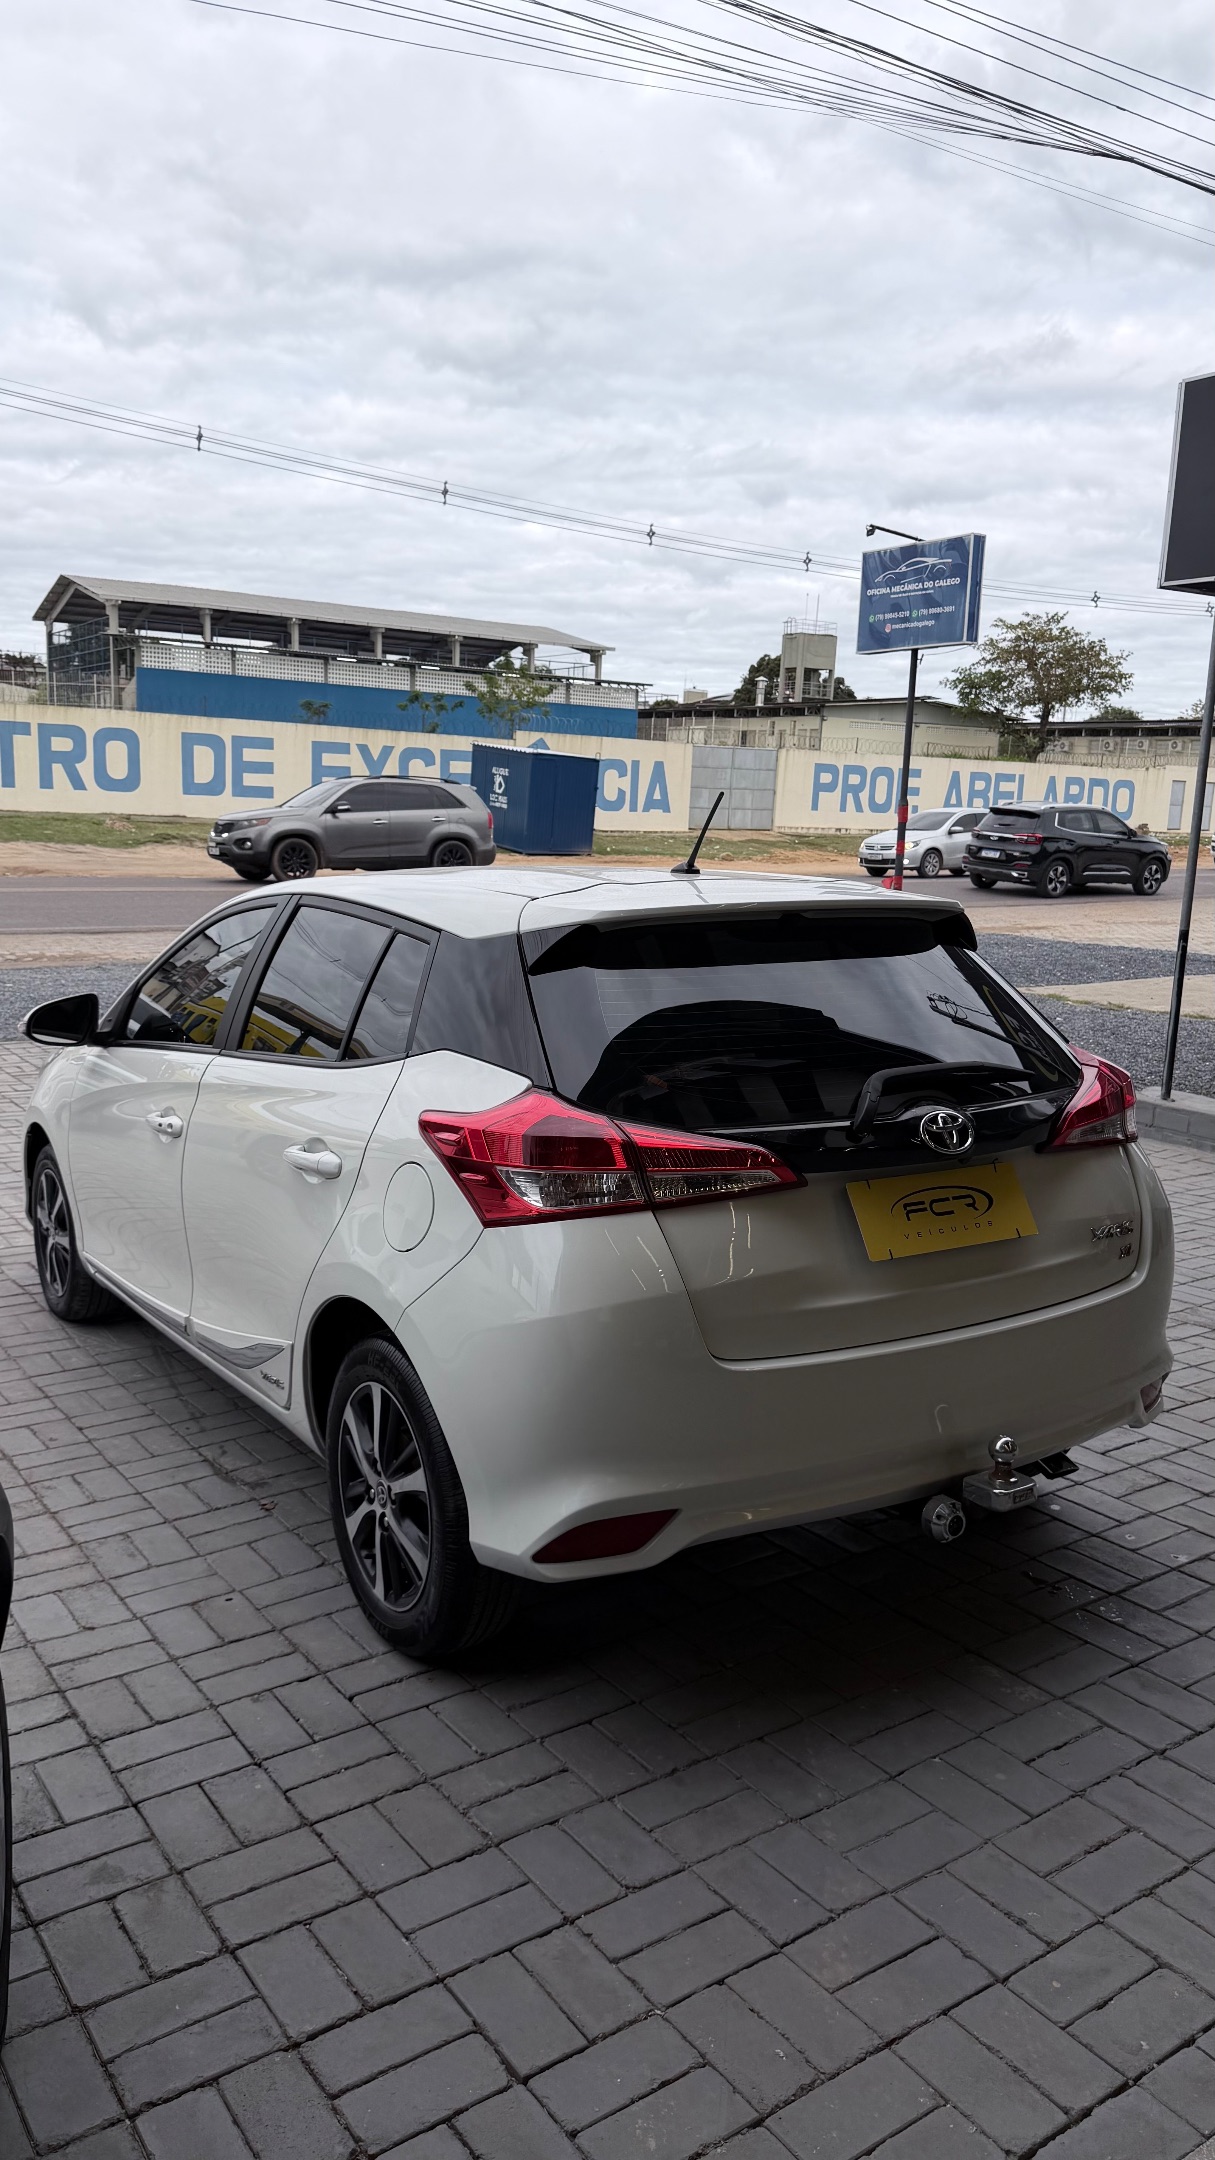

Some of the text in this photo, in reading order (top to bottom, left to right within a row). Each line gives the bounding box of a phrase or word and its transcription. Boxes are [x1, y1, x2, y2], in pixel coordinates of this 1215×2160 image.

[867, 587, 890, 596] OFICINA
[891, 582, 923, 593] MECÂNICA
[924, 580, 934, 588] DO
[935, 578, 960, 587] GALEGO
[181, 732, 274, 799] DE
[903, 1194, 979, 1221] FCR
